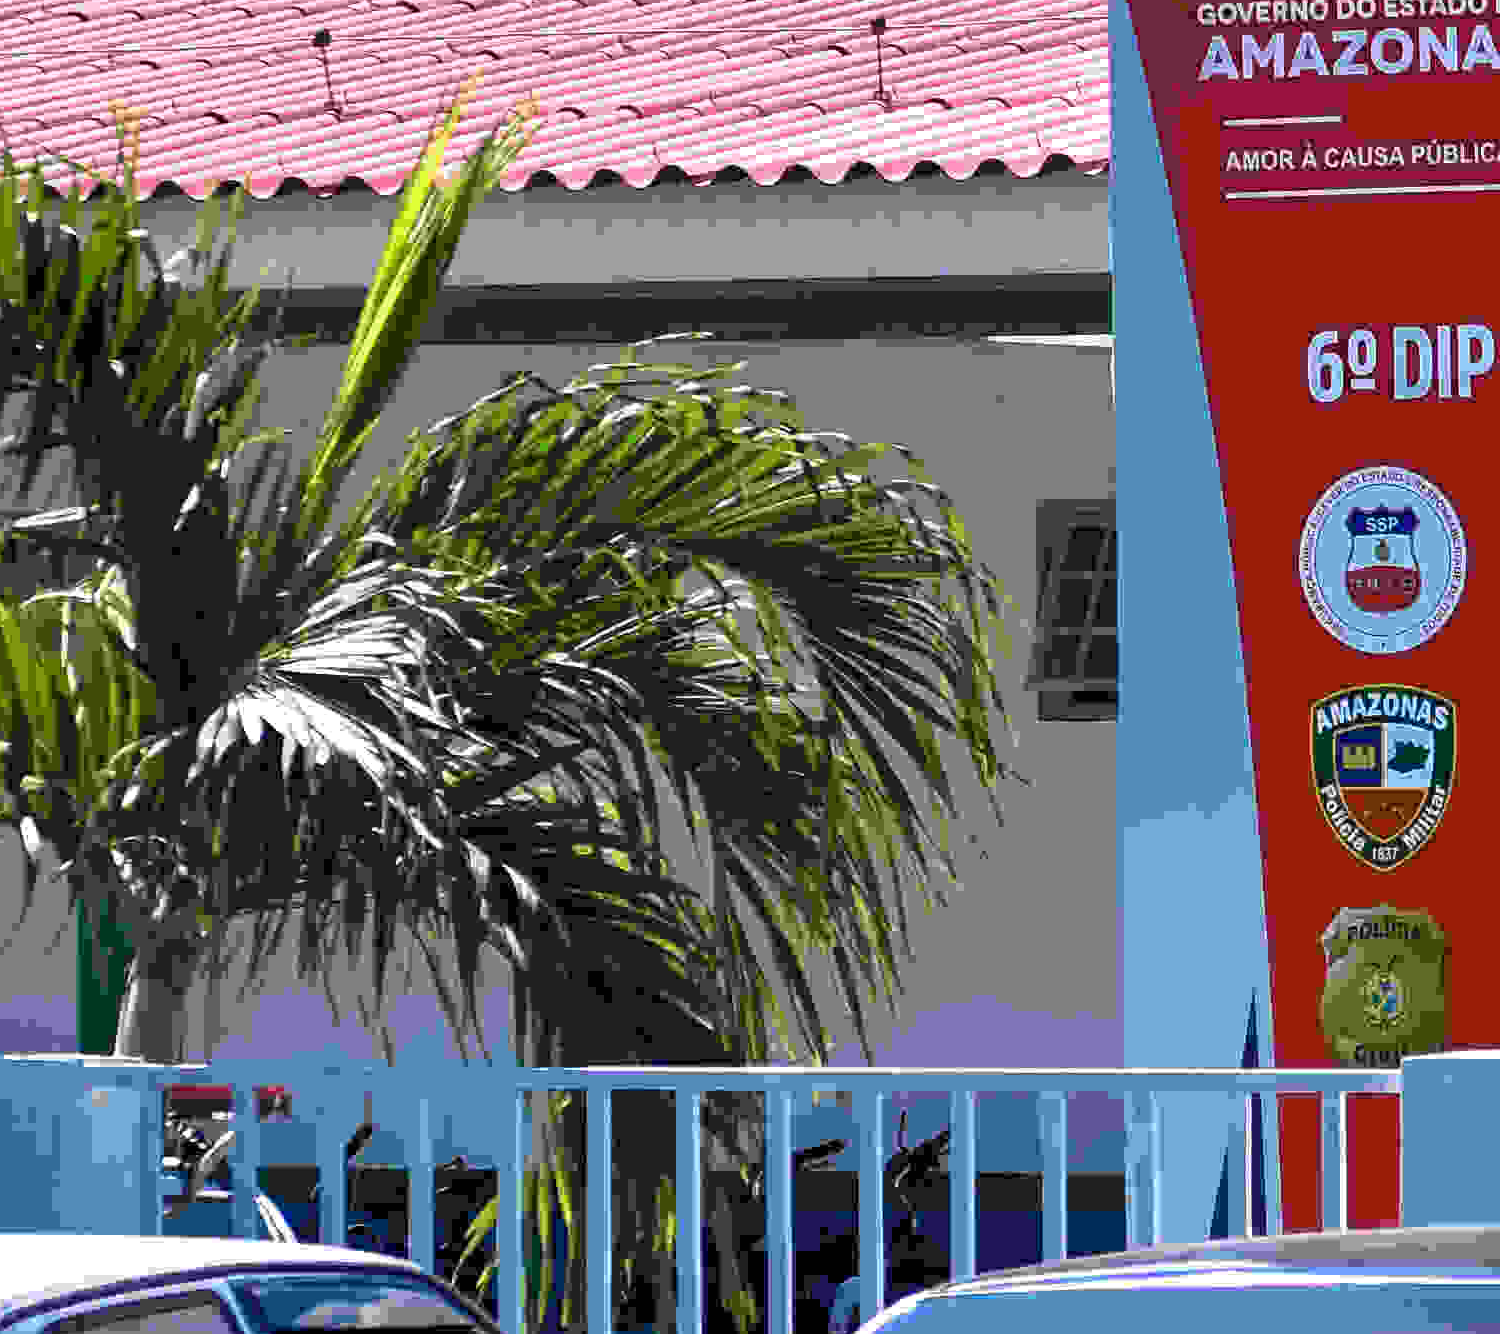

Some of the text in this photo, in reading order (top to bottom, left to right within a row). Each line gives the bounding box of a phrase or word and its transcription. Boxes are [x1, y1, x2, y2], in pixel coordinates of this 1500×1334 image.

[1226, 149, 1294, 172] AMOR
[1301, 140, 1318, 169] À
[1324, 144, 1405, 169] CAUSA
[1393, 324, 1495, 401] DIP
[1364, 517, 1399, 531] SSP
[1315, 690, 1450, 735] AMAZONAS
[1403, 784, 1446, 852] Militar
[1372, 847, 1398, 860] 1837
